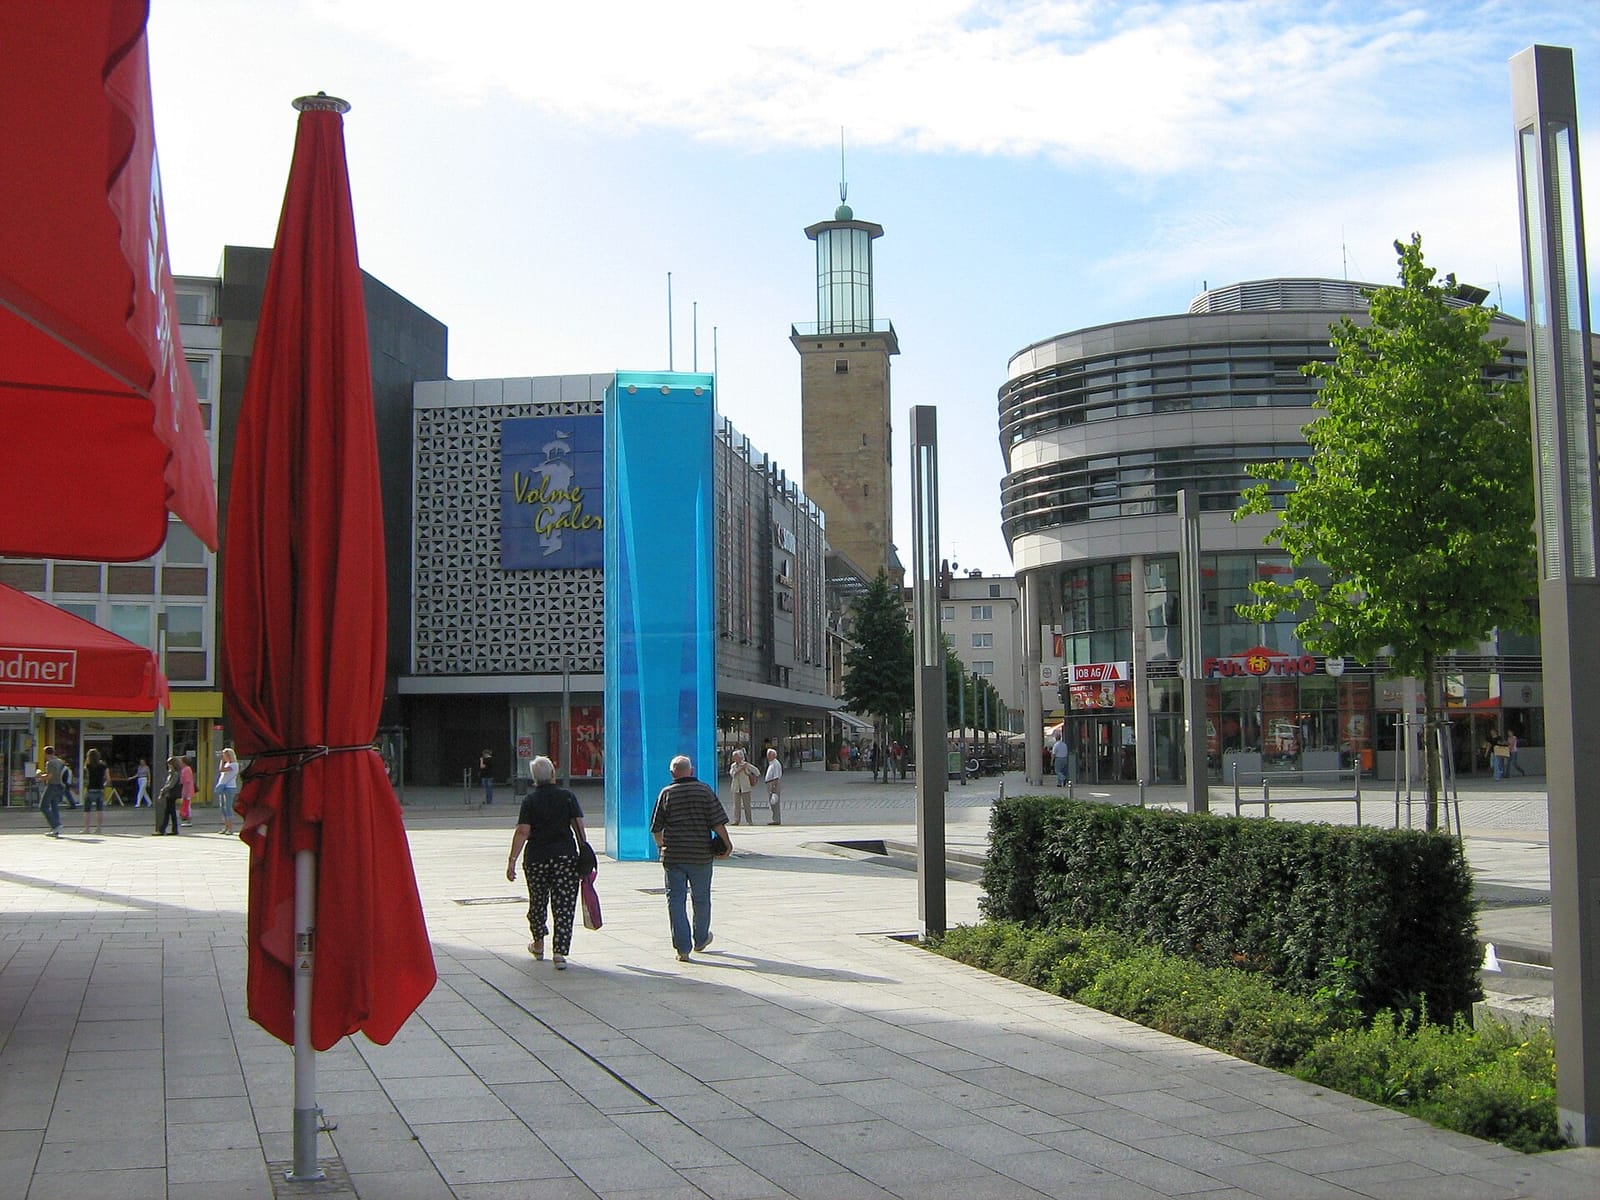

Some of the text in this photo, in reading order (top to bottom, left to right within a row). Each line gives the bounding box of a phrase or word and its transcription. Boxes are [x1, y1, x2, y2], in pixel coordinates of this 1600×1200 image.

[513, 472, 583, 504] Volme
[1075, 667, 1101, 680] JOB AG
